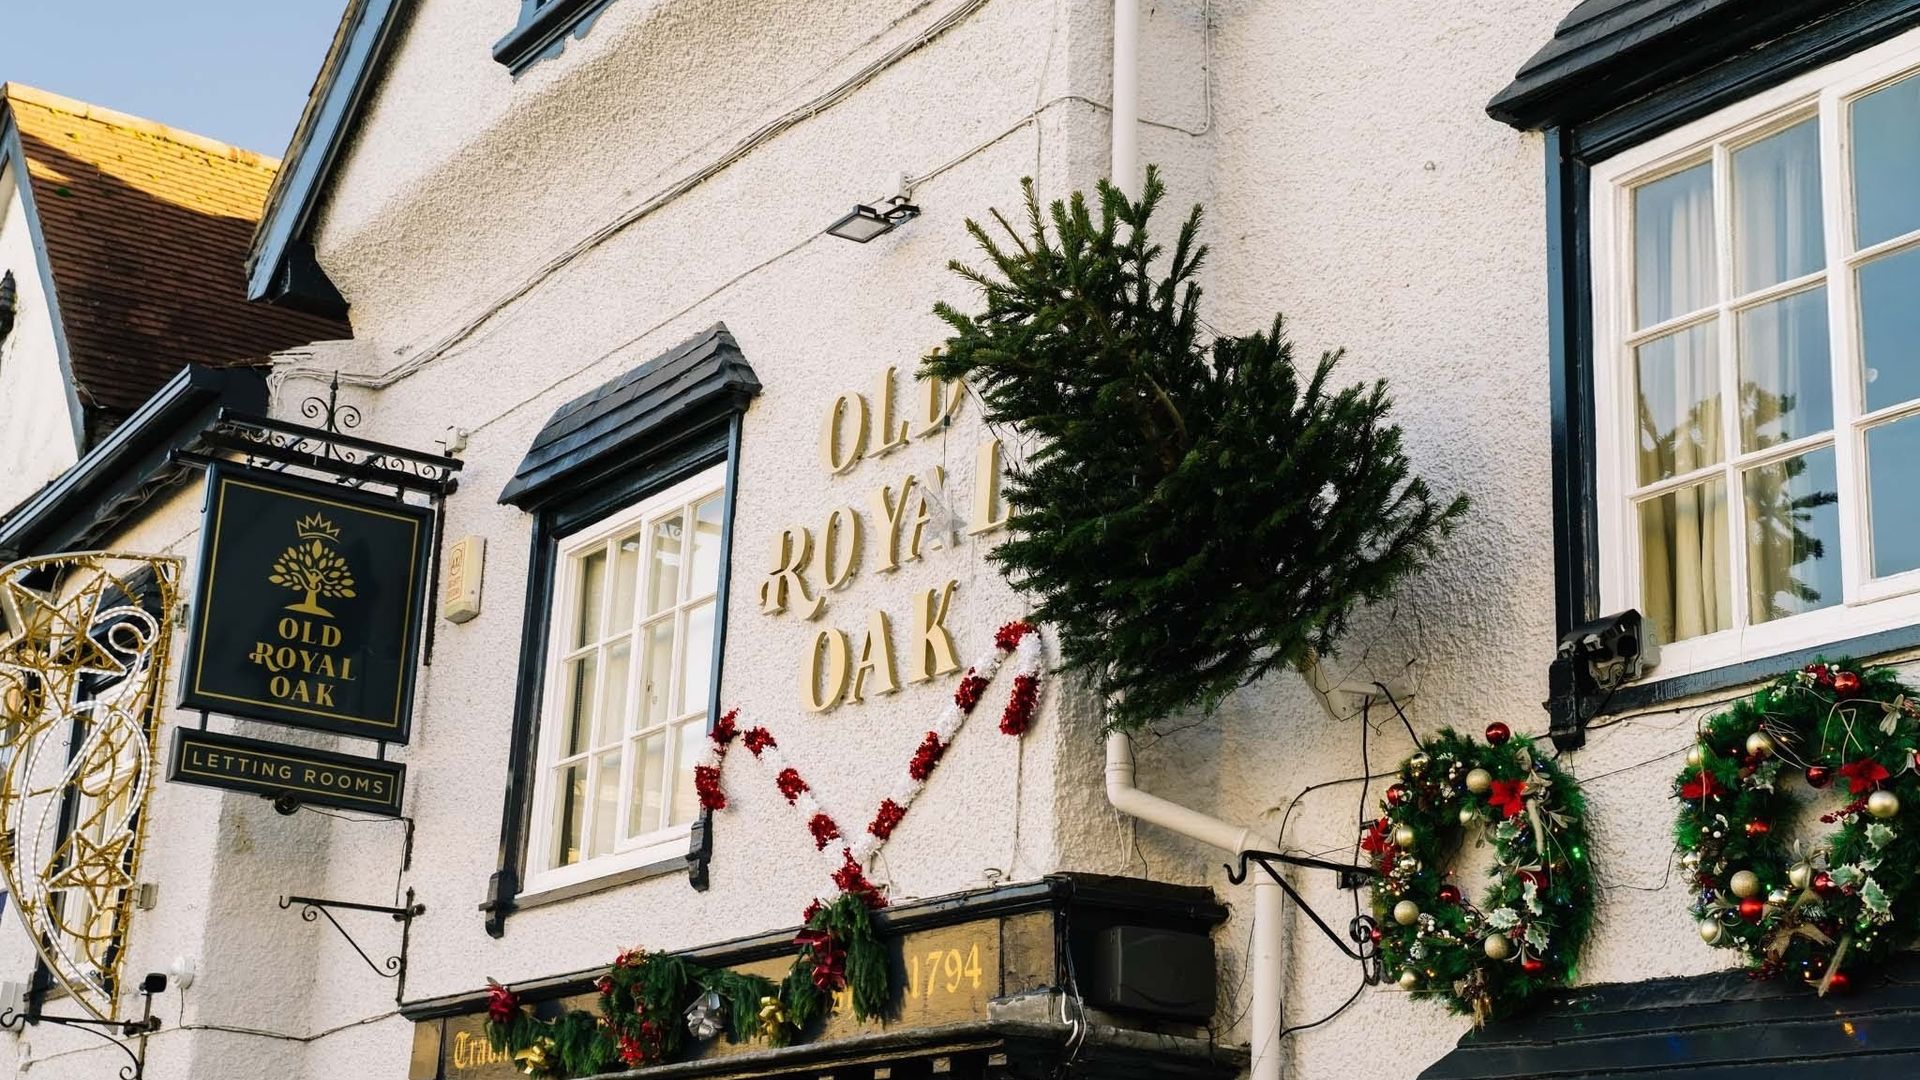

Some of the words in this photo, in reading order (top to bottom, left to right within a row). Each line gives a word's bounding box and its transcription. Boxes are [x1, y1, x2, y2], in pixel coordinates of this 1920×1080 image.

[821, 346, 966, 474] OLD
[759, 438, 1016, 621] ROYAL
[278, 617, 343, 648] OLD
[803, 579, 960, 713] OAK
[249, 641, 356, 681] ROYAL
[269, 675, 336, 707] OAK
[192, 750, 293, 780] LETTING
[303, 770, 384, 795] ROOMS
[911, 942, 983, 999] 1794
